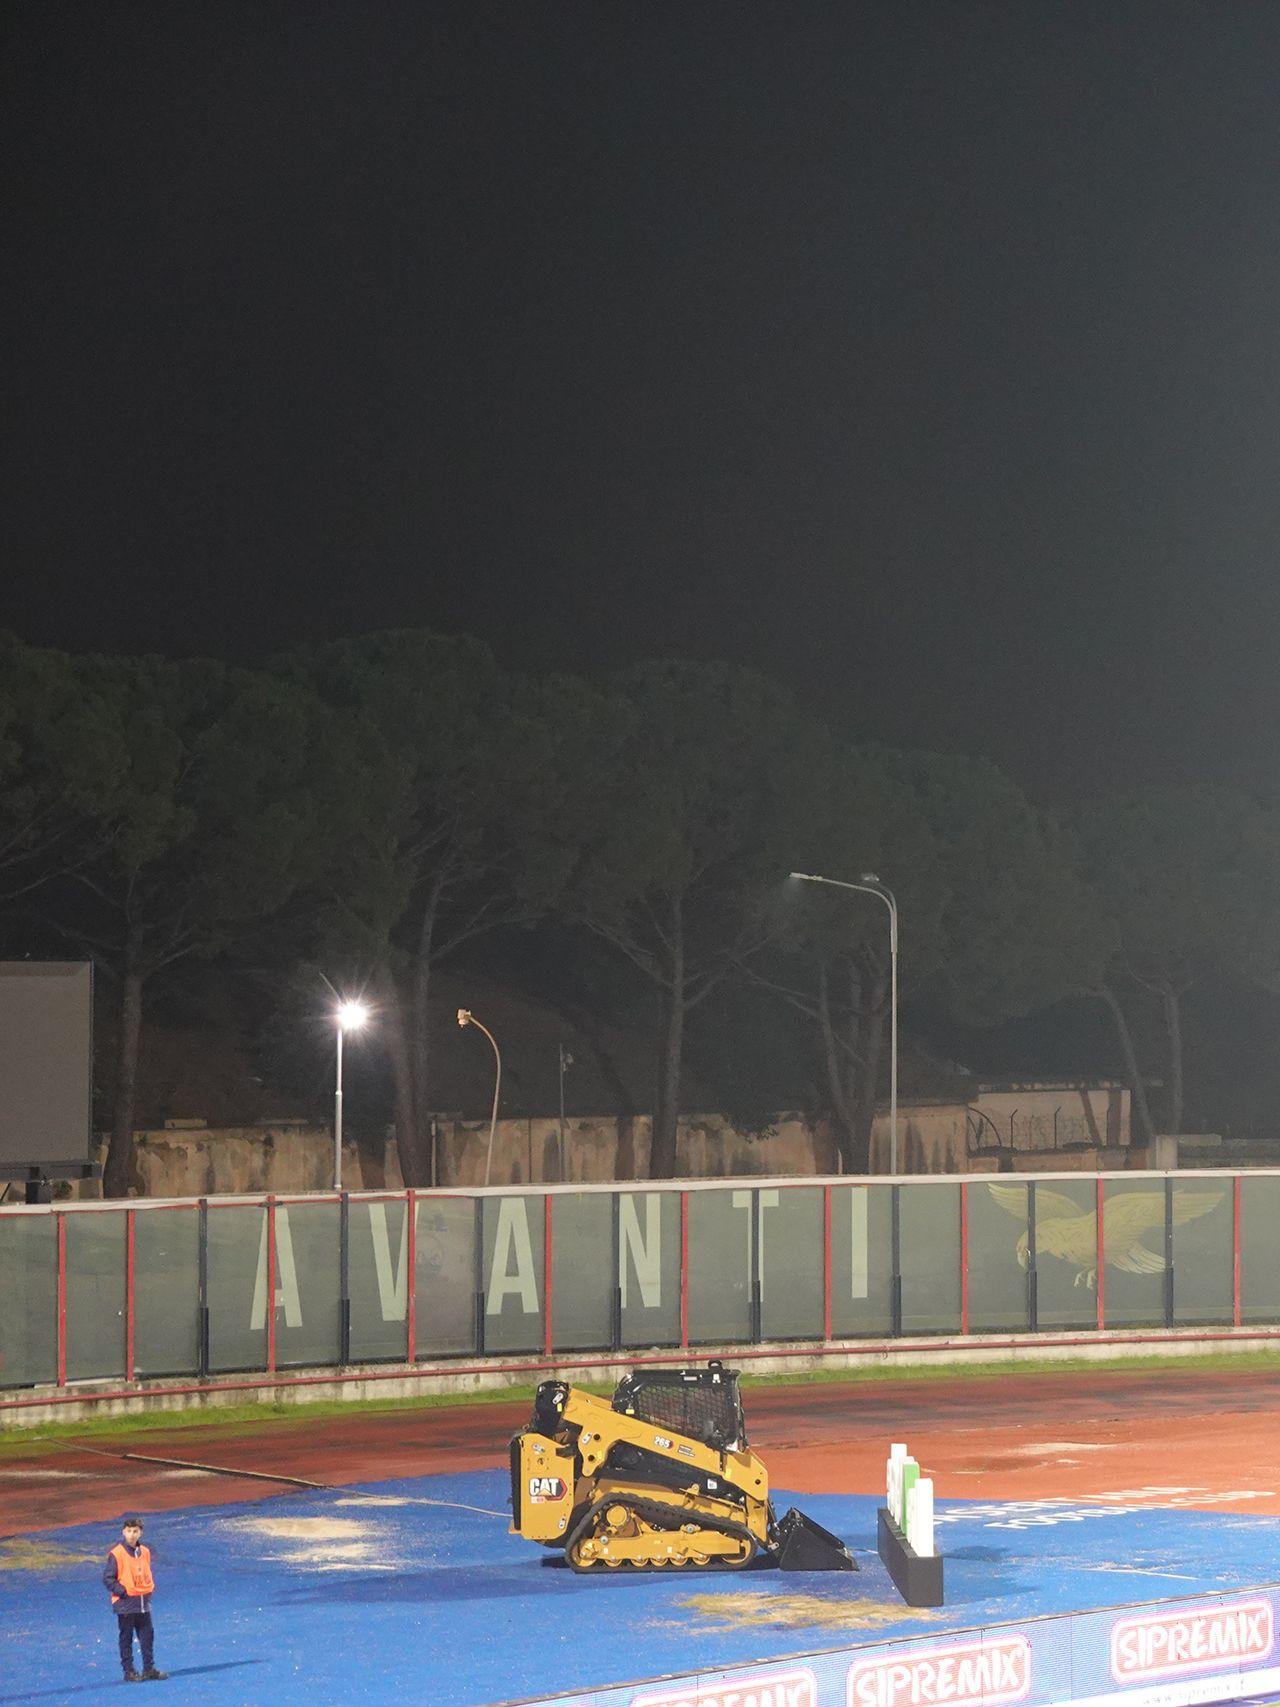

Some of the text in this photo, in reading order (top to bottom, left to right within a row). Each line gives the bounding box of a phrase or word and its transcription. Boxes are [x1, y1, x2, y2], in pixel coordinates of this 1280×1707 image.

[250, 1187, 868, 1330] AVANTI
[654, 1436, 671, 1449] 265
[530, 1478, 559, 1496] CAT
[1118, 1606, 1265, 1670] SIPREMIX
[857, 1647, 1022, 1707] SIPREMIX
